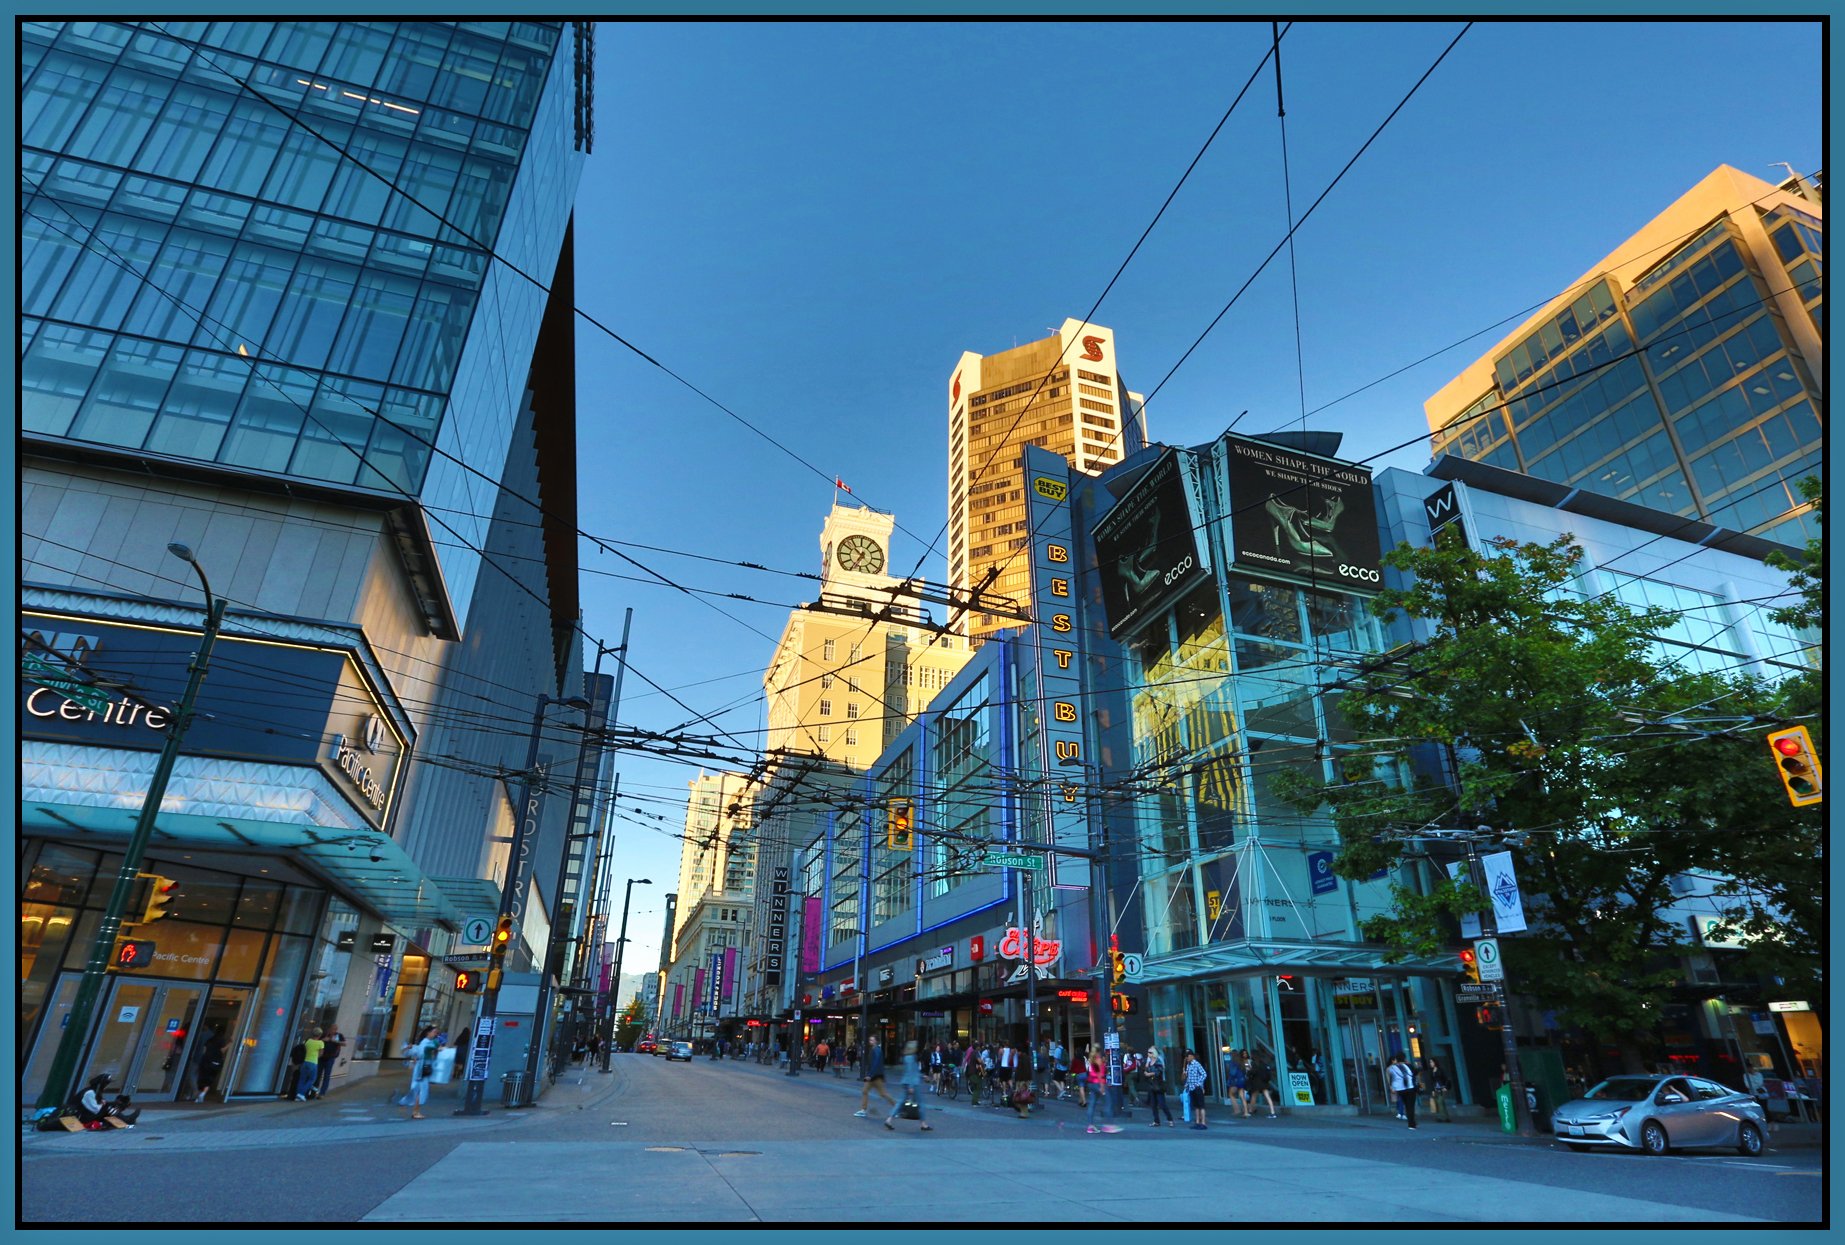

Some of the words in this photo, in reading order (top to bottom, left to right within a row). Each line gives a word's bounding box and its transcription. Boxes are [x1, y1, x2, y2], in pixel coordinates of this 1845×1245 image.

[1234, 445, 1273, 462] WOMEN
[1275, 456, 1309, 471] SHAPE
[1310, 463, 1331, 477] THE
[1333, 469, 1368, 486] WORLD
[1265, 469, 1276, 477] WE
[1277, 473, 1299, 484] SHAPE
[1321, 482, 1342, 492] SHOES
[1038, 480, 1065, 492] BEST
[1039, 487, 1062, 497] BUY
[1096, 520, 1116, 542] WOMEN
[1117, 499, 1135, 522] SHAPE
[1136, 484, 1150, 502] THE
[1149, 461, 1172, 487] WORLD
[1164, 555, 1193, 586] ecco
[1241, 550, 1291, 565] eccocanada.com
[1338, 563, 1380, 582] ecco
[1047, 545, 1073, 669] BEST
[26, 687, 171, 728] Centre
[1055, 702, 1078, 802] BUY
[336, 734, 364, 785] Pacific
[361, 767, 385, 811] Centre
[509, 761, 547, 938] NRDSTRO
[990, 854, 1024, 866] Robson
[1026, 858, 1036, 867] St
[770, 869, 788, 967] WINNERS
[1245, 898, 1295, 908] WNERS
[152, 951, 179, 962] Pacific
[181, 954, 210, 965] Centre
